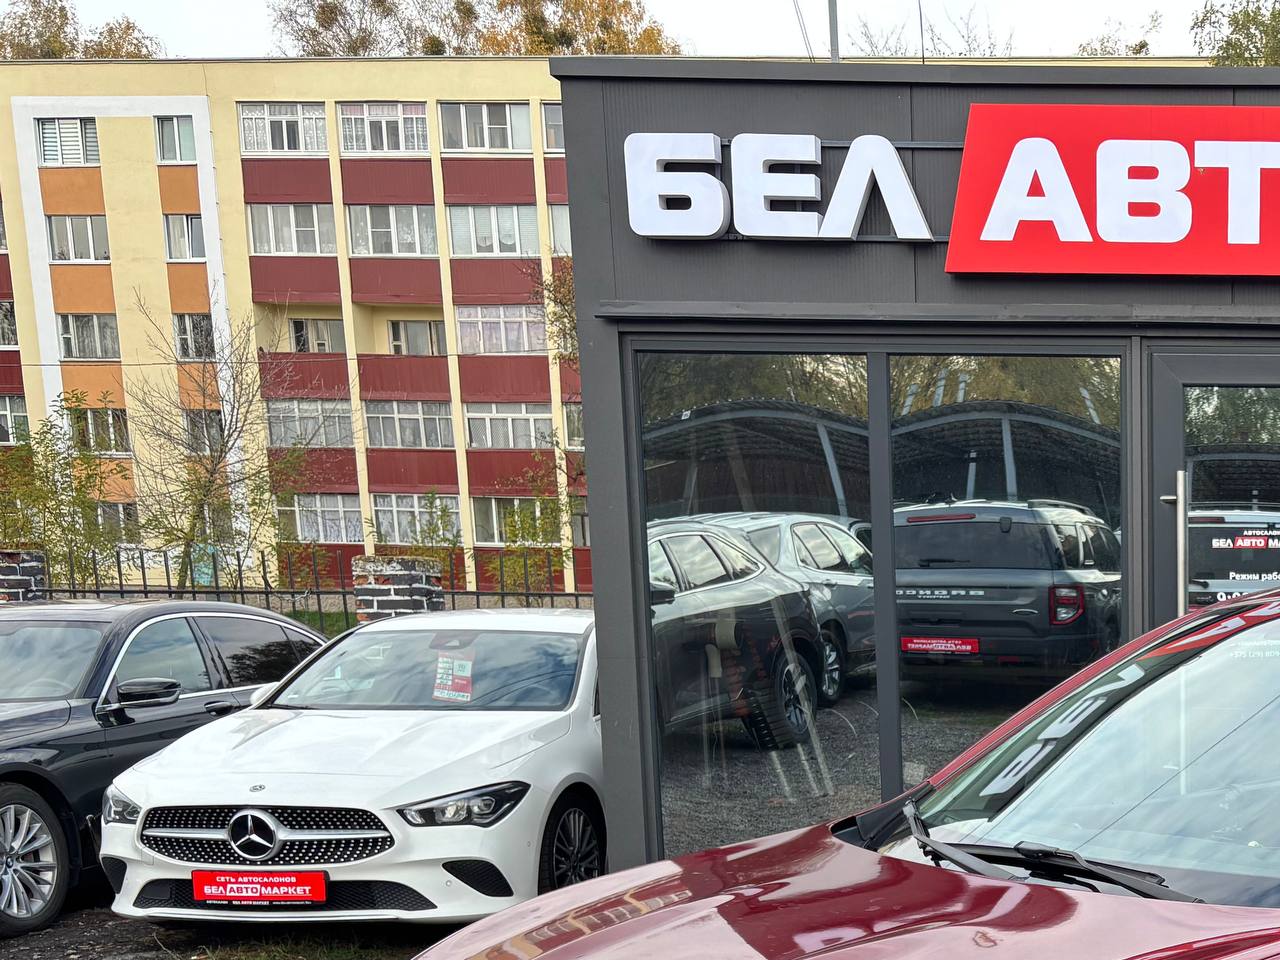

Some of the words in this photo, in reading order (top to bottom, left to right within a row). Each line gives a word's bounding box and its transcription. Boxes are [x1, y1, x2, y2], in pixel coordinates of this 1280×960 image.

[624, 131, 934, 241] БЕЛ
[1212, 539, 1233, 548] БЕЛ
[1236, 539, 1265, 547] АВТО
[1229, 572, 1259, 580] Режим
[204, 886, 225, 894] БЕЛ
[228, 885, 260, 894] АВТО
[261, 886, 311, 895] МАРКЕТ
